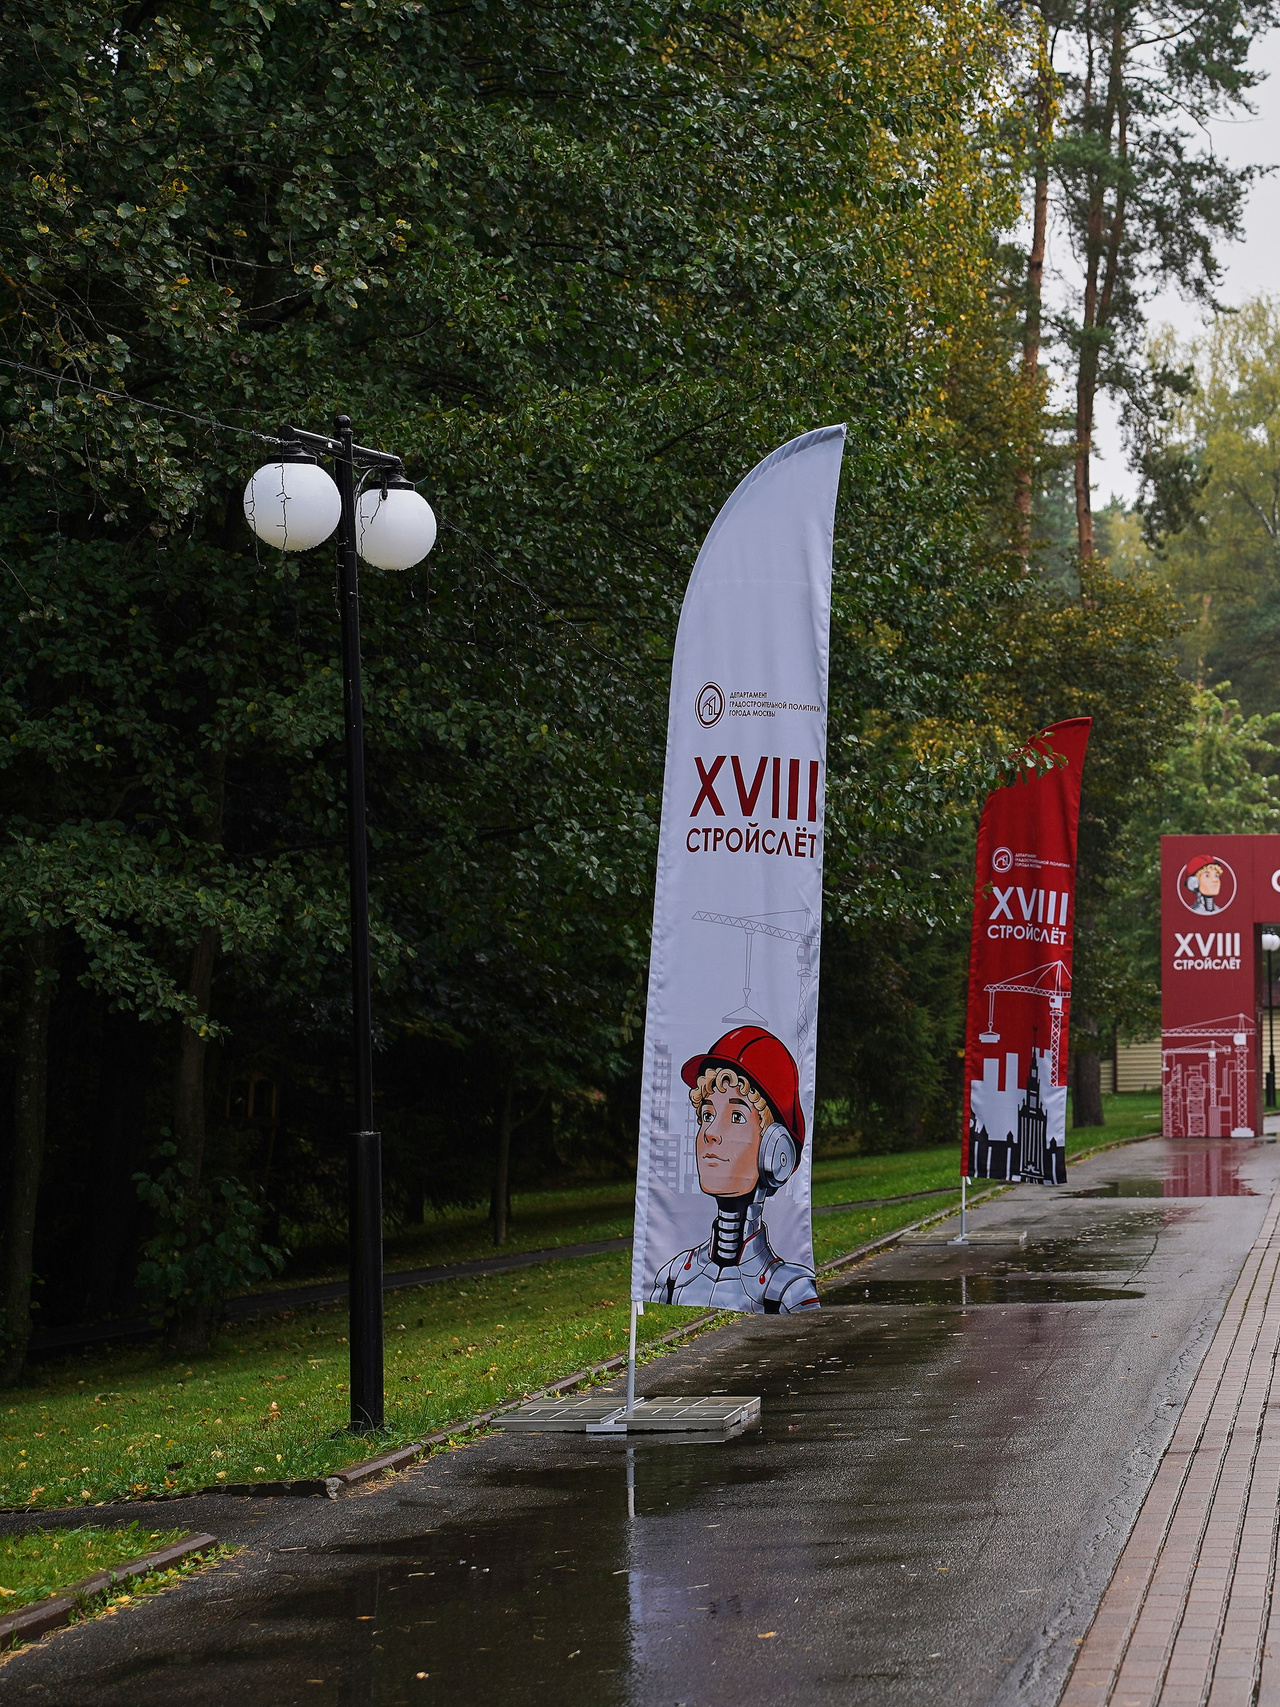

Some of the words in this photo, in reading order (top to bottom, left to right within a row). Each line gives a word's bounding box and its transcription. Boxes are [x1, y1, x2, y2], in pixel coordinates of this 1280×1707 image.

[729, 691, 768, 699] ДЕПАРТАМЕНТ
[729, 701, 788, 709] ГРАДОСТРОИТЕЛЬНОЙ
[788, 703, 821, 712] ПОЛИТИКИ
[729, 709, 751, 717] ГОРОДА
[689, 755, 820, 823] XVIII
[686, 822, 817, 859] СТРОЙСЛЁТ
[988, 886, 1069, 926] XVIII
[987, 922, 1067, 946] СТРОЙСЛЁТ
[1174, 932, 1241, 957] XVIII
[1173, 956, 1242, 971] СТРОЙСЛЁТ
